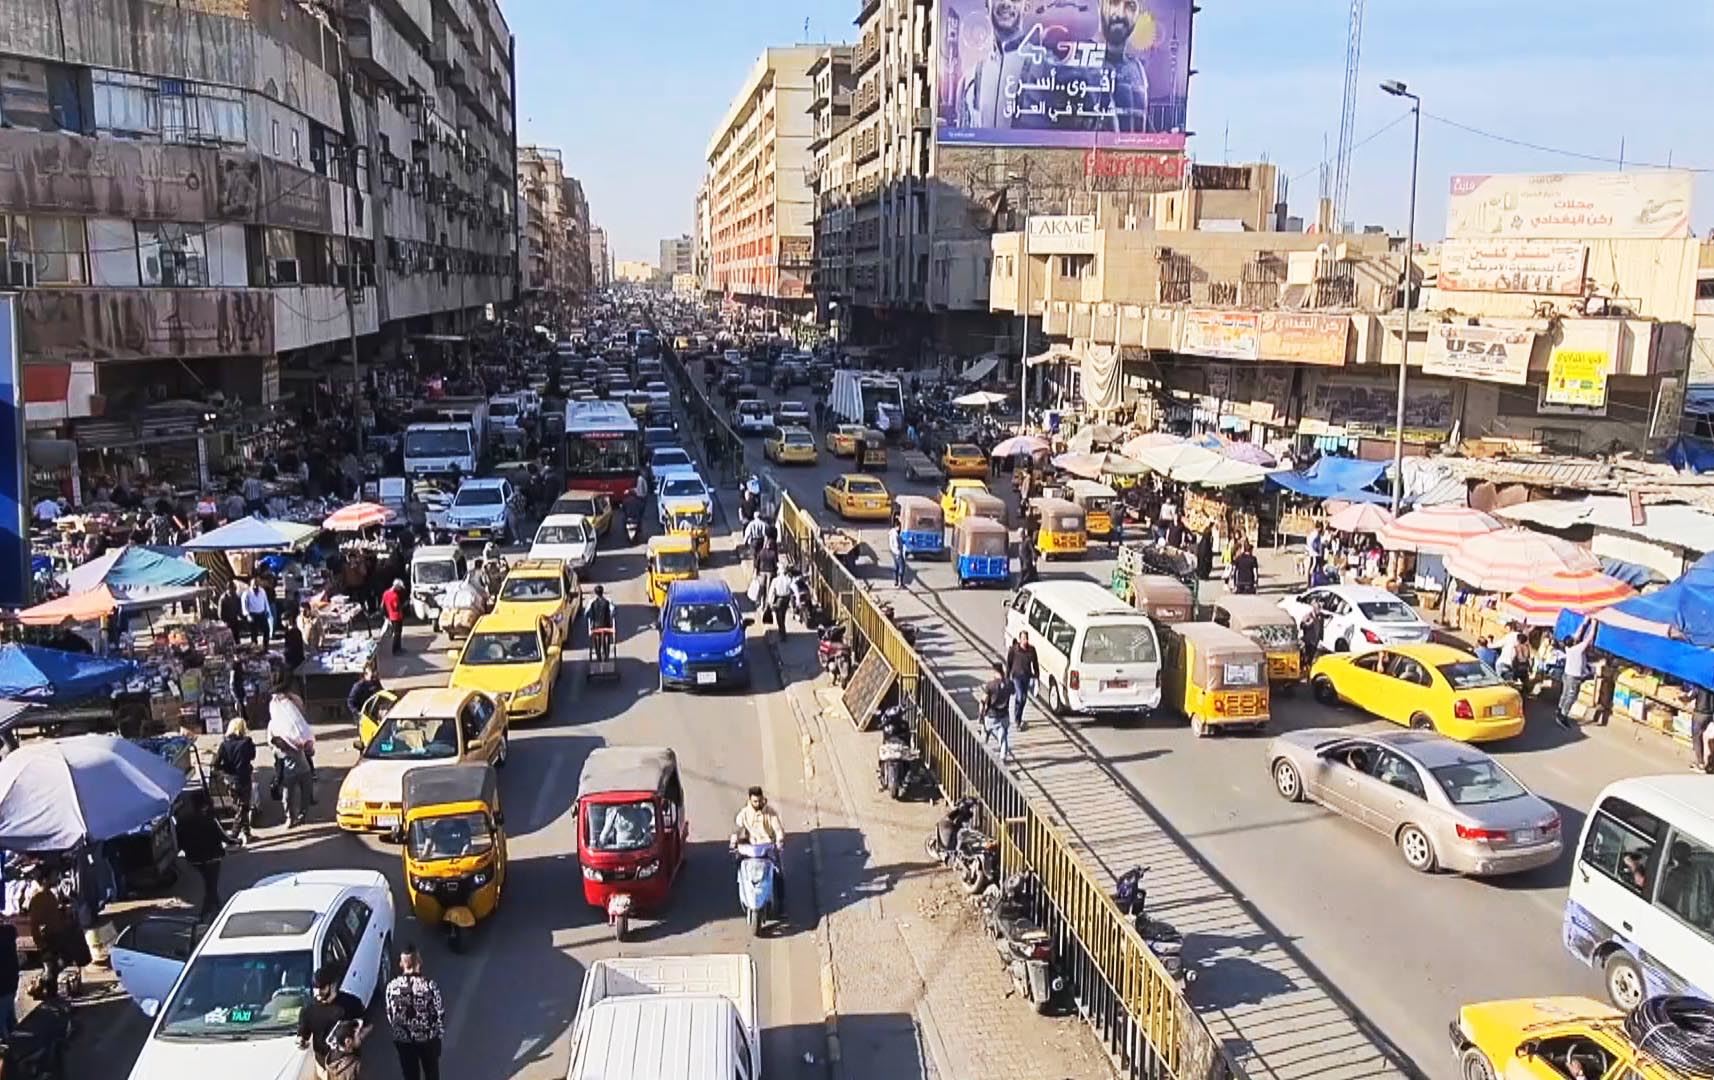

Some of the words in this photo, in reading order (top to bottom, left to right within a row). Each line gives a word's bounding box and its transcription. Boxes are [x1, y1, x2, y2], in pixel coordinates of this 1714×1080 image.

[1003, 100, 1046, 118] العراق
[1048, 100, 1073, 122] في
[1076, 101, 1116, 120] شبكة
[1530, 213, 1585, 228] البغدادي
[1586, 211, 1613, 226] ركن
[1275, 317, 1318, 332] البغدادي
[1319, 317, 1345, 335] ركن
[1446, 339, 1508, 357] USA
[231, 1008, 251, 1021] TAXI
